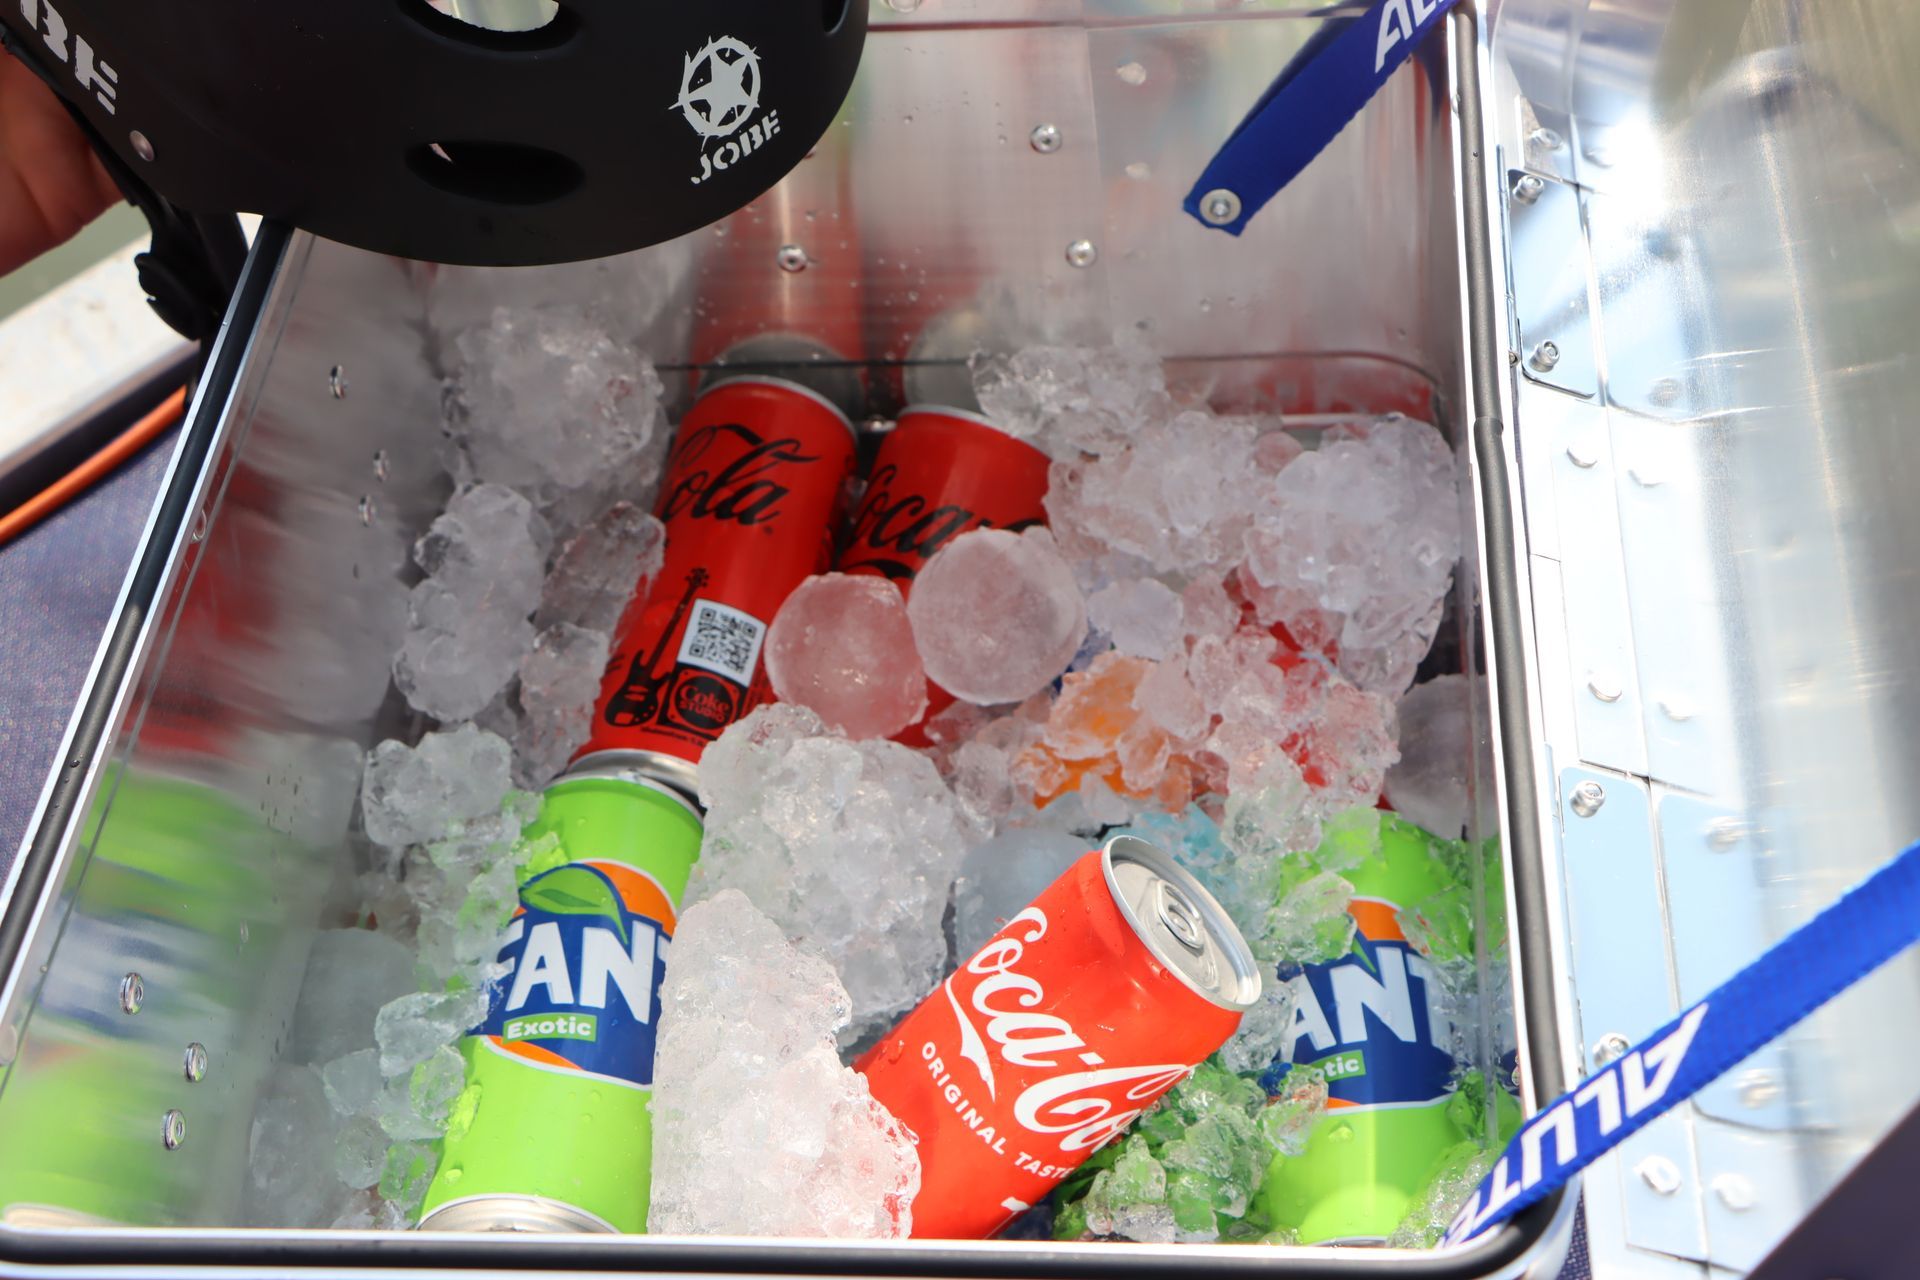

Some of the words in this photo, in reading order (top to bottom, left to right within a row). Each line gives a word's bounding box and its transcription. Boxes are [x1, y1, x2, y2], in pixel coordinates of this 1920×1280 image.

[1374, 0, 1444, 74] AL
[690, 109, 780, 184] JOBE
[680, 684, 730, 714] Coke
[680, 700, 726, 722] STUDIO
[507, 1016, 591, 1040] Exotic
[922, 1041, 1005, 1155] ORIGINAL
